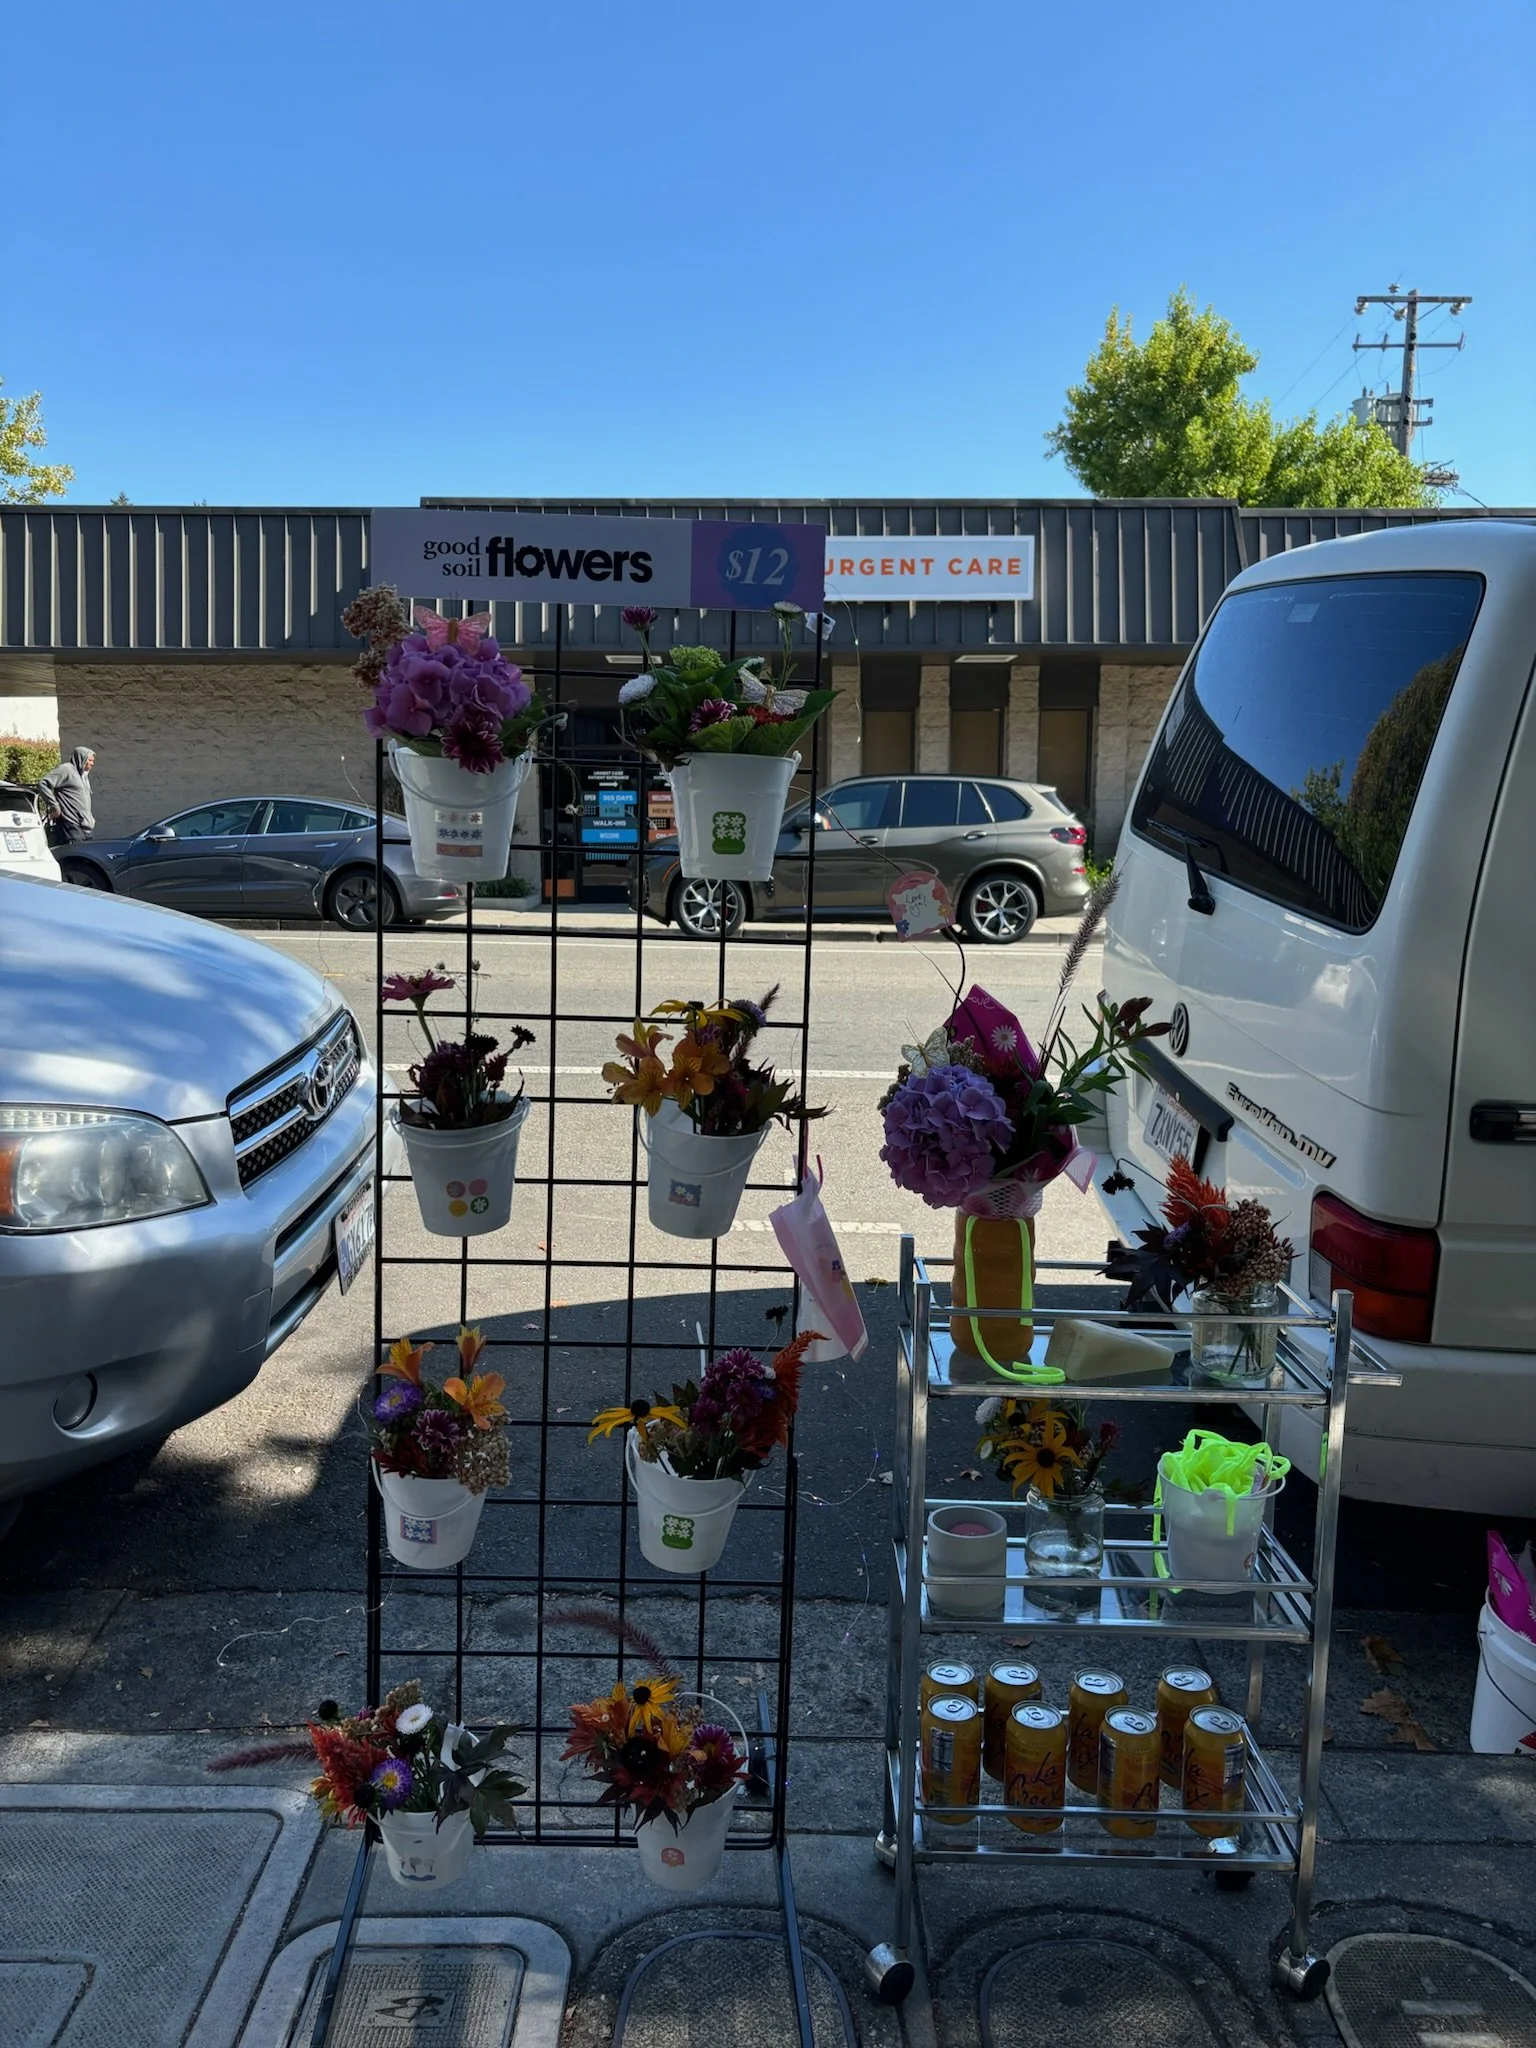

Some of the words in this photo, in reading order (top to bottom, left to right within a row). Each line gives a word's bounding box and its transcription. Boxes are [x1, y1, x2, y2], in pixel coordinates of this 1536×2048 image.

[423, 535, 481, 560] good
[485, 535, 653, 584] flowers
[442, 557, 482, 577] soil
[725, 547, 789, 586] $12
[947, 557, 1022, 576] CARE
[968, 996, 995, 1010] ove
[1030, 1751, 1057, 1786] La
